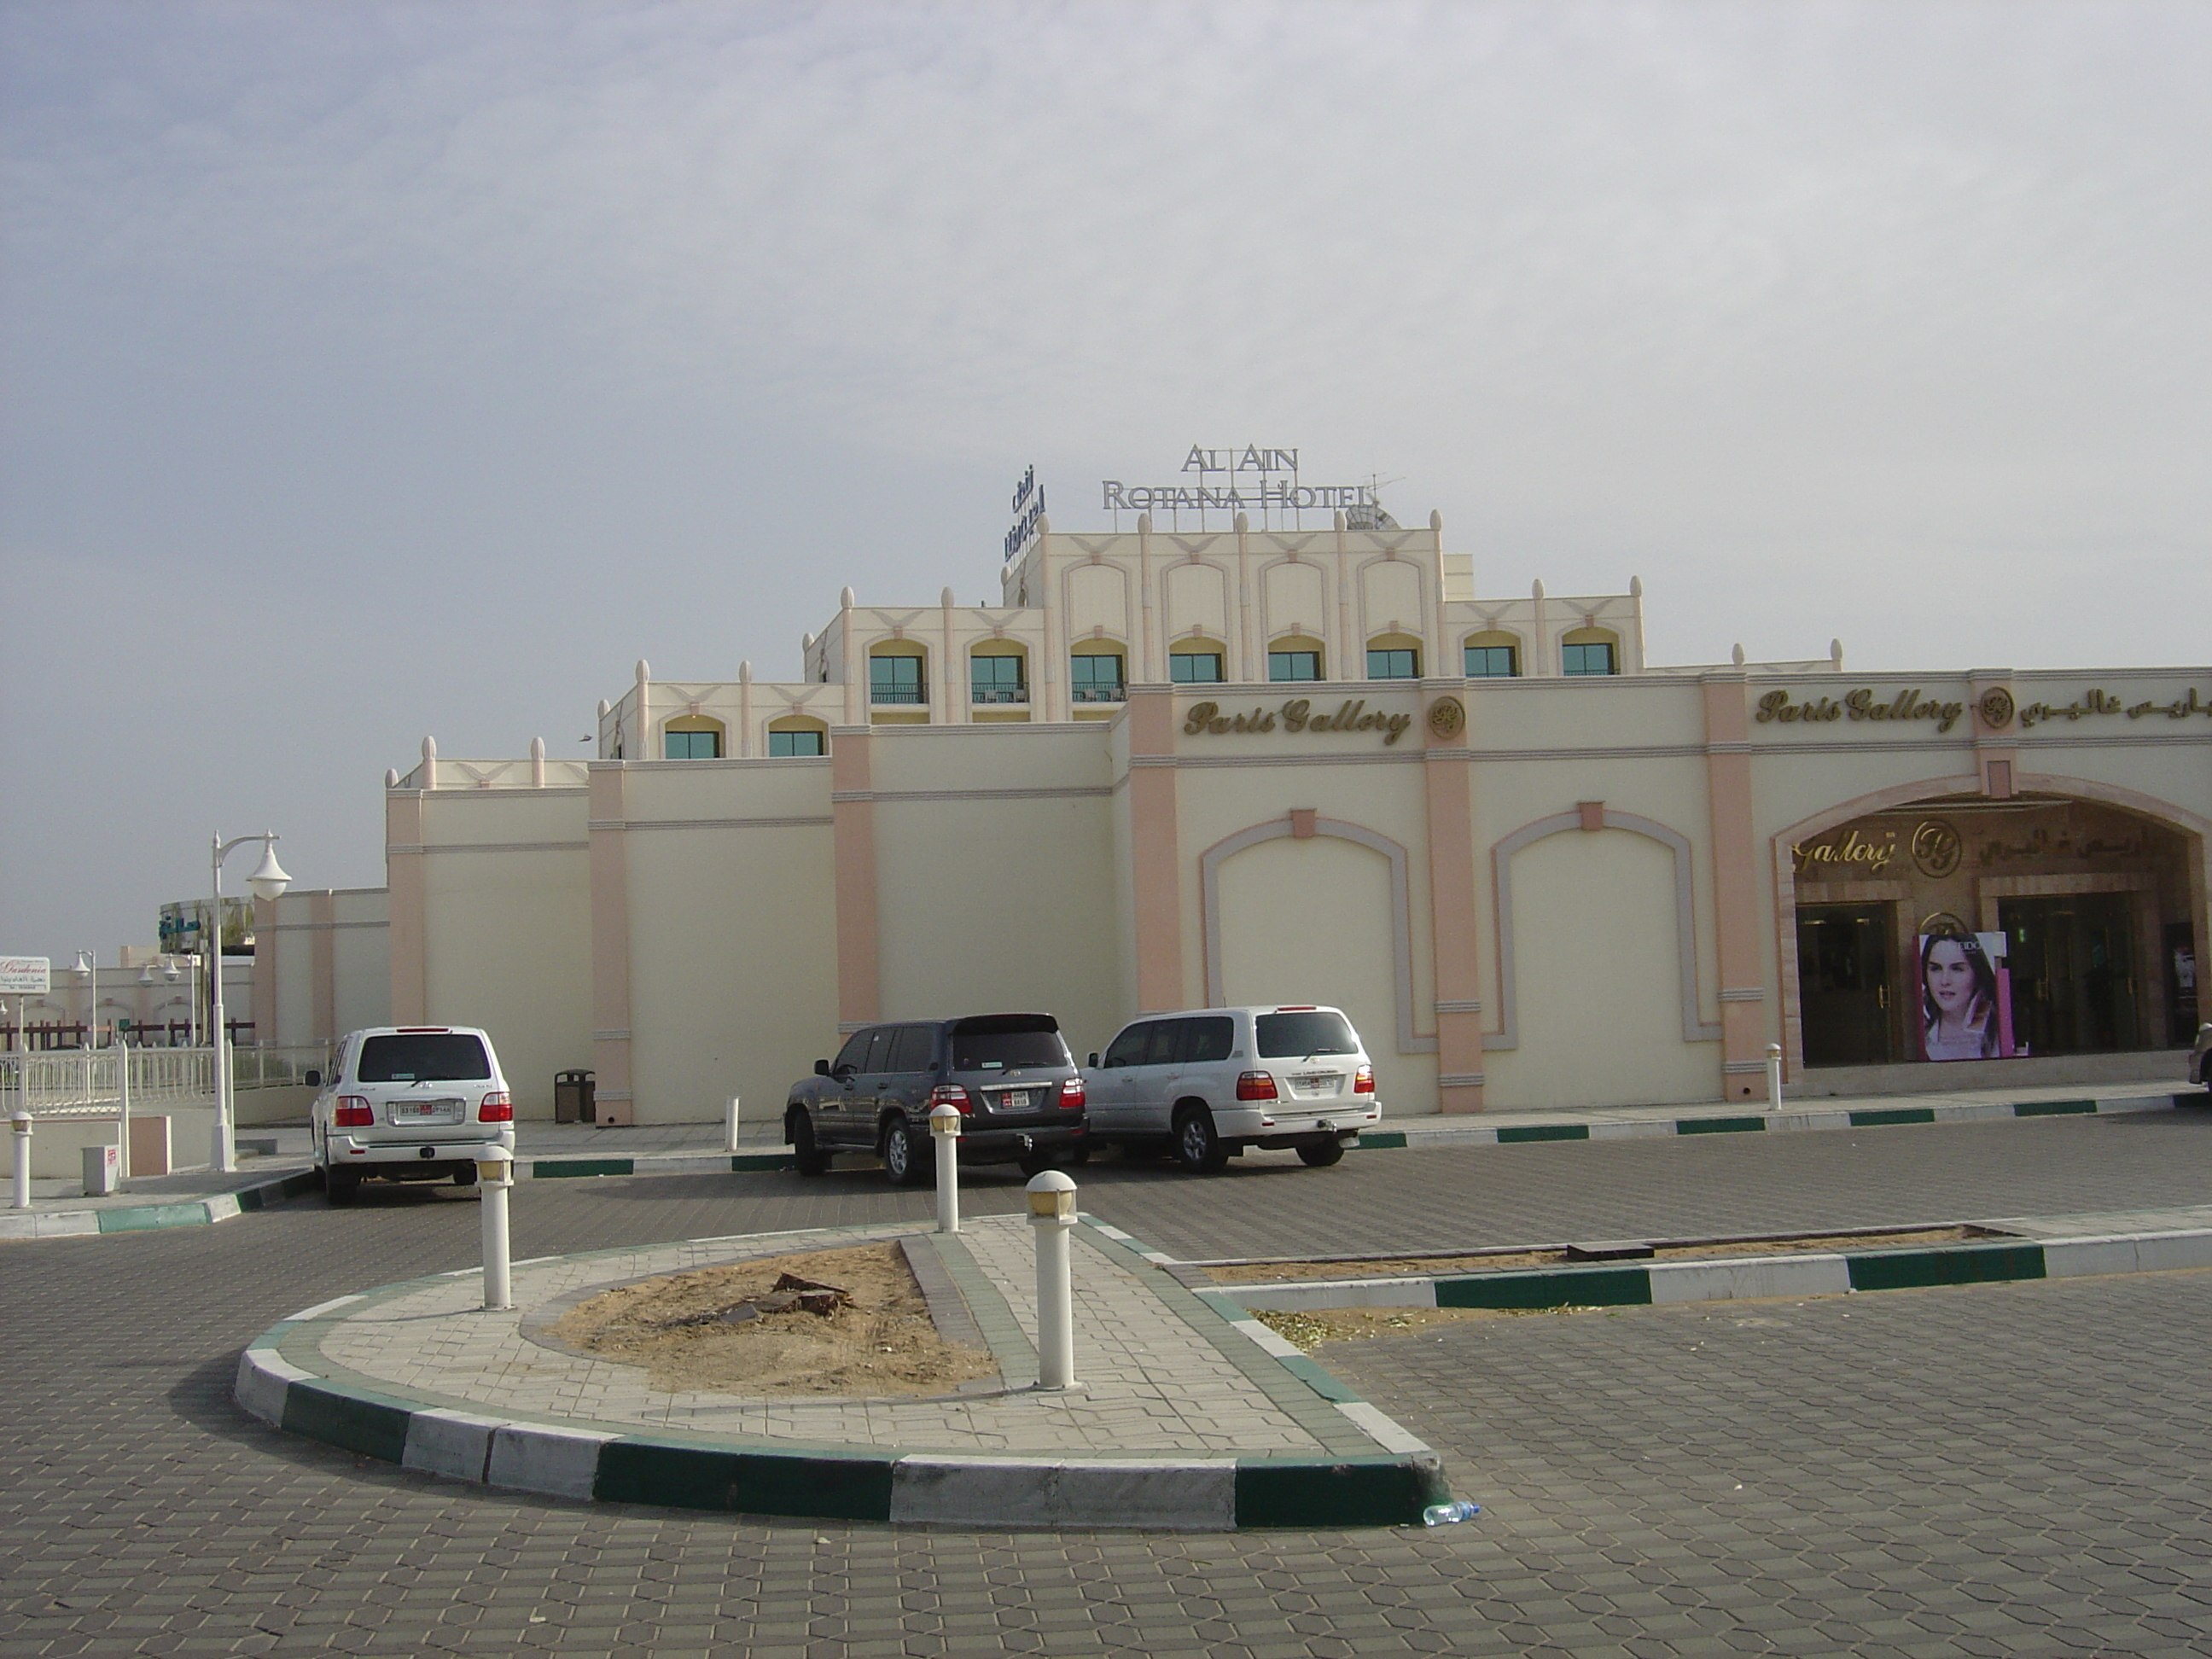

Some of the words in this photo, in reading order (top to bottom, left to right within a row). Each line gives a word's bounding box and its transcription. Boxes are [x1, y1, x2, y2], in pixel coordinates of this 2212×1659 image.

[1181, 443, 1225, 472] AL
[1238, 443, 1298, 471] AIN
[1103, 480, 1246, 509] ROTANA
[1260, 479, 1376, 509] HOTEL
[1183, 701, 1277, 736] Paris
[1280, 698, 1412, 746] Gallery
[1755, 689, 1842, 724] Paris
[1843, 688, 1962, 733] Gallery
